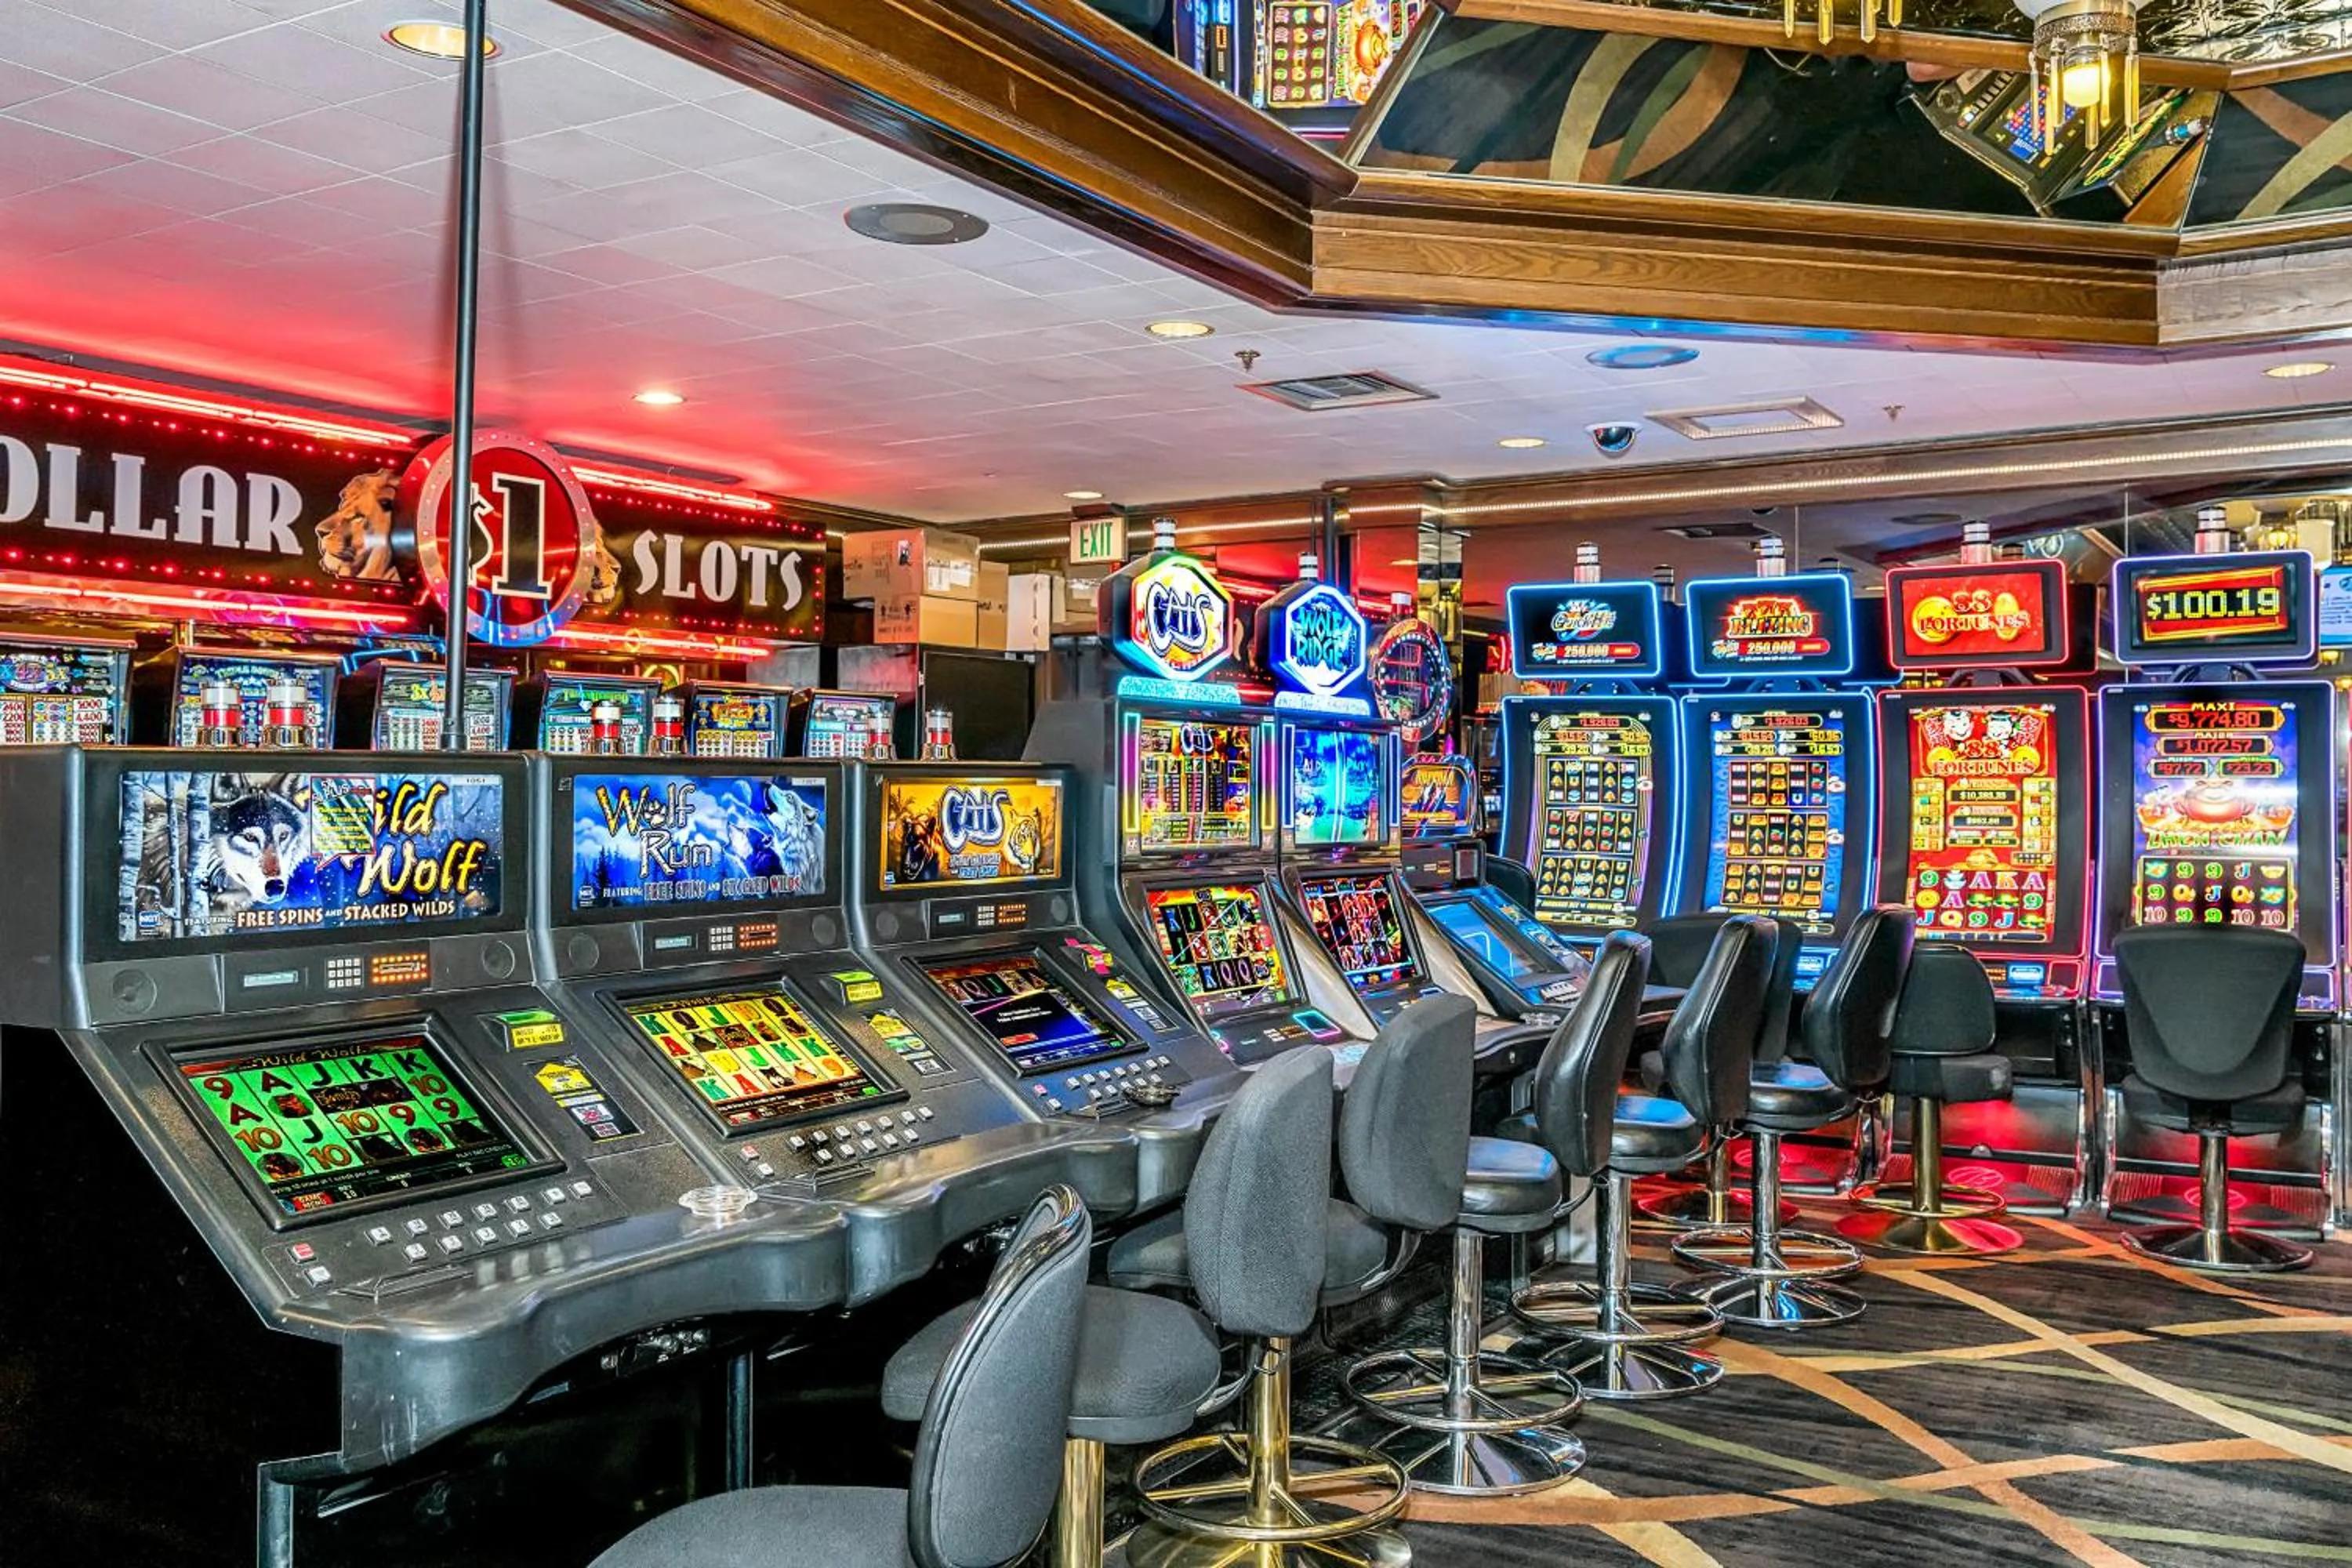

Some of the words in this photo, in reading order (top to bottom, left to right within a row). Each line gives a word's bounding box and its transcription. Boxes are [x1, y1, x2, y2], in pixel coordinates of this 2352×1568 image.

[1079, 521, 1113, 558] EXIT
[632, 528, 802, 611] SLOTS
[2147, 588, 2280, 620] $100.19
[1919, 611, 2031, 633] FORTUNES
[1296, 636, 1344, 672] RIDGE
[2191, 702, 2234, 711] MAXI
[1964, 739, 2002, 759] 88
[1931, 759, 2036, 776] FORTUNES
[596, 782, 696, 837] Wolf
[942, 786, 1013, 853] CATS
[339, 839, 487, 897] Wolf
[638, 829, 713, 878] Run
[1969, 871, 1992, 889] A
[1995, 871, 2019, 889] K
[2021, 872, 2045, 891] A
[238, 910, 274, 927] FREE
[278, 908, 323, 925] SPINS
[344, 903, 408, 920] STACKED
[412, 900, 456, 916] WILDS
[1940, 891, 1965, 909] A
[636, 1014, 670, 1036] K
[706, 1006, 730, 1025] J
[659, 1036, 690, 1057] A
[746, 1047, 770, 1067] J
[769, 1042, 801, 1062] K
[798, 1036, 829, 1057] K
[203, 1076, 234, 1099] 9
[261, 1071, 293, 1094] A
[311, 1063, 332, 1088] J
[353, 1058, 385, 1080] K
[394, 1051, 428, 1074] K
[696, 1078, 731, 1102] K
[732, 1073, 762, 1095] A
[230, 1102, 263, 1126] A
[408, 1074, 447, 1096] 10
[235, 1127, 283, 1152] 10
[302, 1119, 324, 1144] J
[335, 1110, 379, 1135] 10
[388, 1102, 416, 1126] 9
[433, 1098, 459, 1118] 9
[306, 1143, 352, 1171] 10
